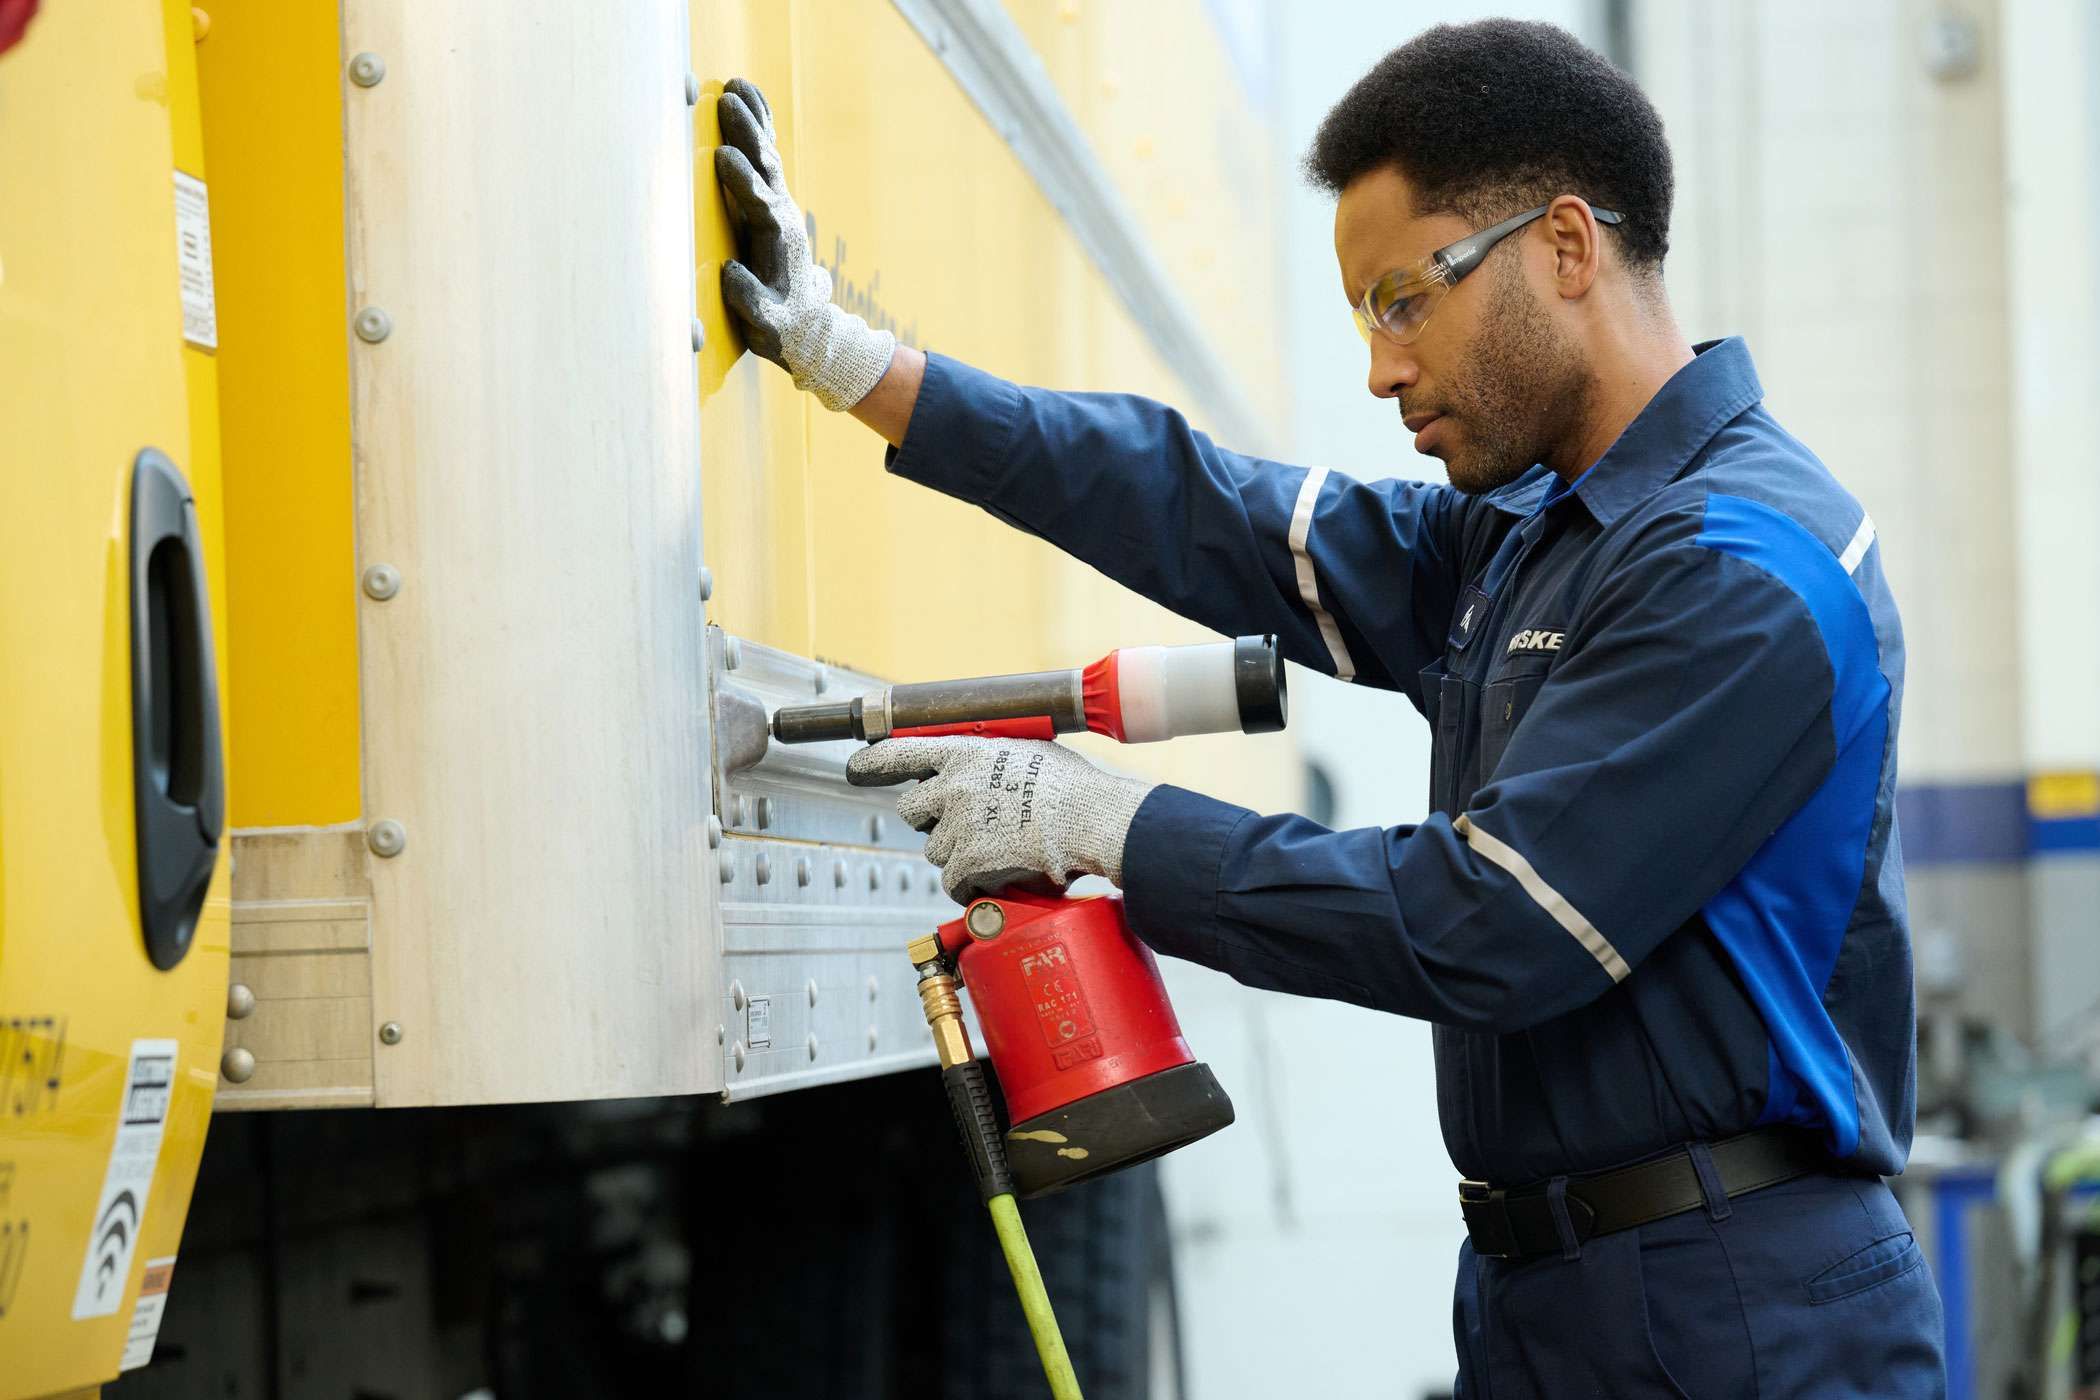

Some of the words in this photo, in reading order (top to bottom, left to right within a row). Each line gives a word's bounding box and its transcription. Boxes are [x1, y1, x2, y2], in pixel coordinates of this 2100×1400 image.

[990, 751, 1010, 789] 88282
[1028, 754, 1043, 778] CUT
[1006, 783, 1018, 792] 3
[987, 806, 998, 824] XL
[1021, 782, 1036, 828] LEVEL
[1038, 999, 1057, 1013] RAC
